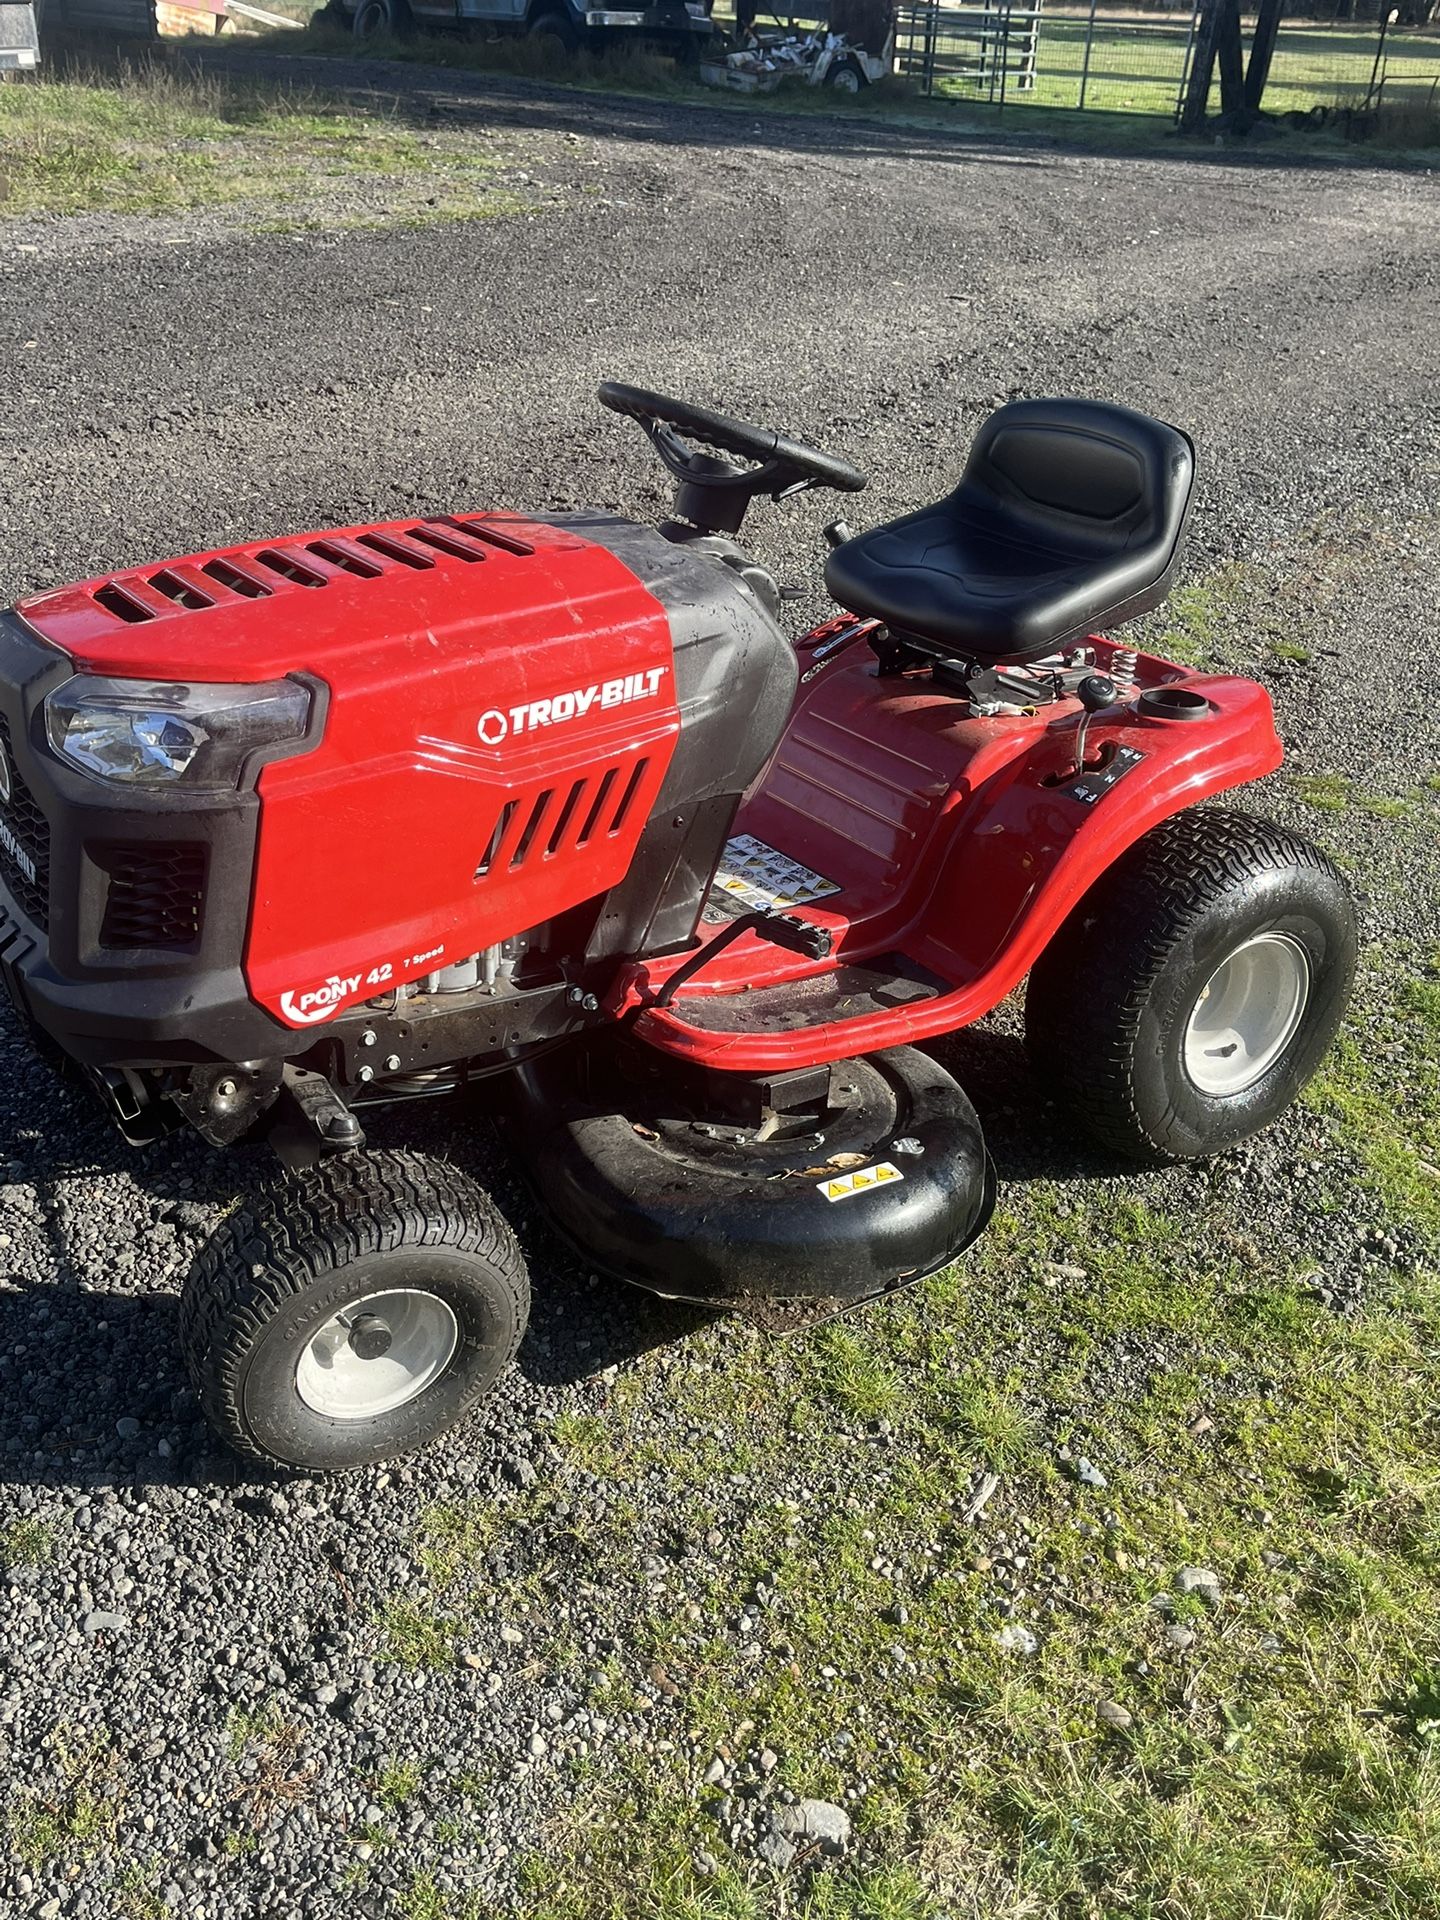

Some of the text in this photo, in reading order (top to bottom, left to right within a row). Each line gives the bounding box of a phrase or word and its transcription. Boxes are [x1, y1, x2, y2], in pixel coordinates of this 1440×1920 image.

[508, 666, 666, 735] TROY-BILT
[1104, 774, 1116, 783] N
[1085, 793, 1098, 802] F
[403, 944, 445, 968] 7 Speed
[300, 963, 393, 1011] PONY 42
